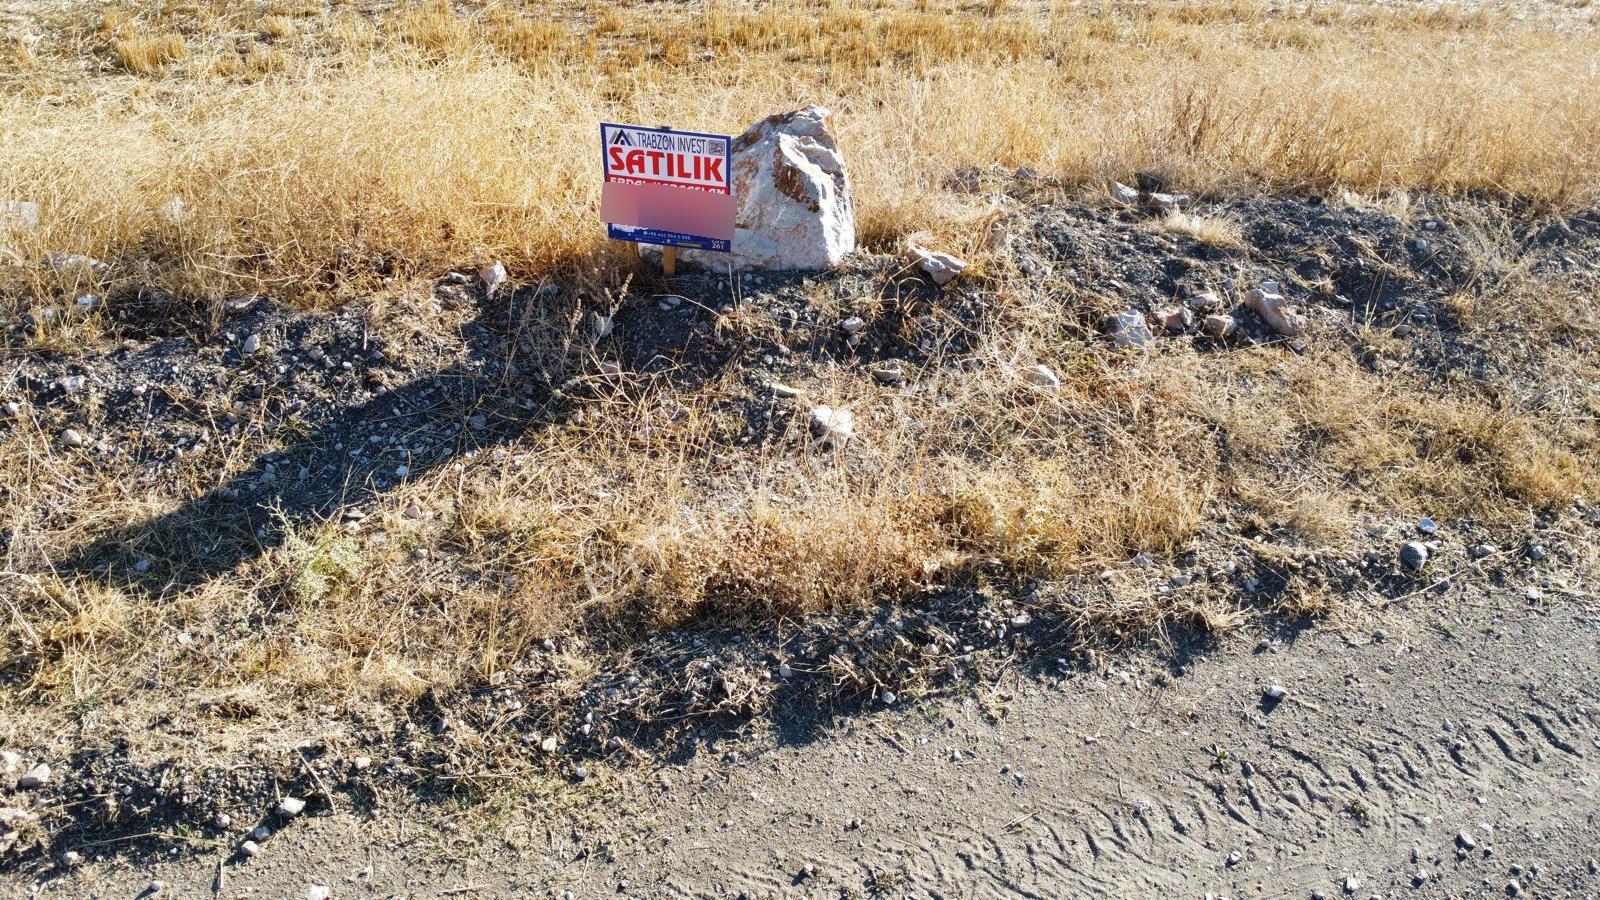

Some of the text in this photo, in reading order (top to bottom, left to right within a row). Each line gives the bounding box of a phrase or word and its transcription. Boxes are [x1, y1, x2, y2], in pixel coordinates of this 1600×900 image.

[637, 132, 707, 155] TRABZON INVEST
[609, 146, 724, 183] SATILIK
